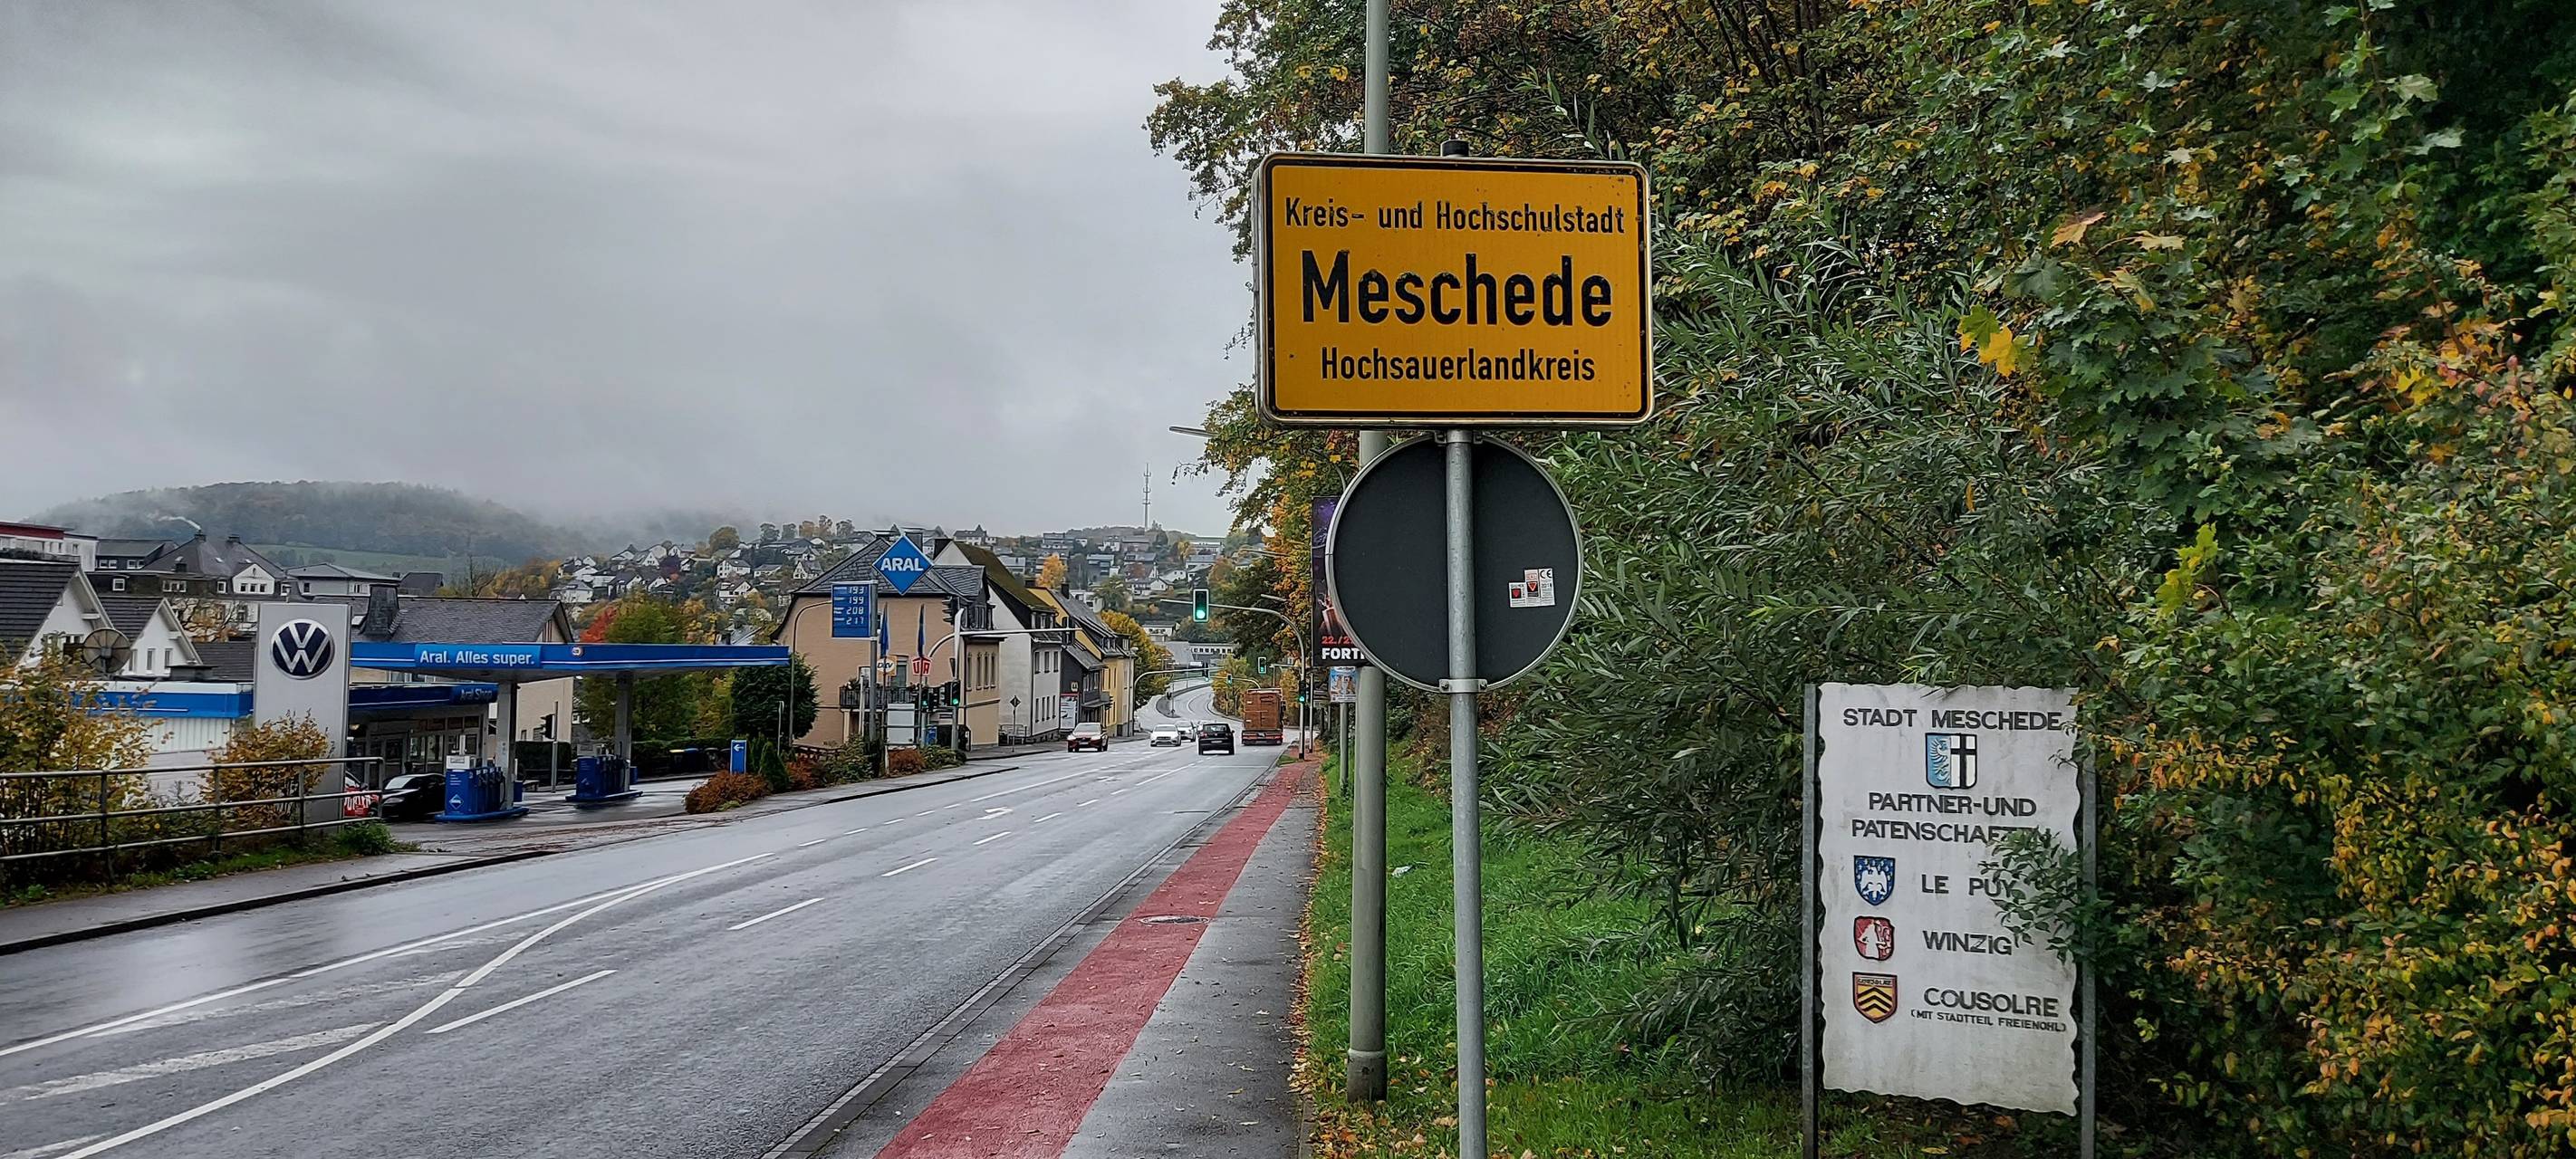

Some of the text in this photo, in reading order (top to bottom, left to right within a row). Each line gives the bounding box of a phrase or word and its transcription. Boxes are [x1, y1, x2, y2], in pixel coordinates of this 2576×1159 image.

[1285, 196, 1625, 234] Kreis- und Hochschulstadt
[1302, 249, 1612, 327] Meschede
[1321, 346, 1596, 381] Hochsauerlandkreis
[880, 558, 924, 571] ARAL
[846, 607, 864, 615] 208
[1322, 636, 1353, 645] 22./2
[419, 650, 535, 666] Aral. Alles super.
[1843, 708, 2062, 731] STADT MESCHEDE
[1869, 792, 2037, 817] PARTNER-UND
[1851, 819, 2051, 848] PATENSCHAF
[1921, 874, 2016, 897] LE PUY
[1924, 987, 2059, 1018] COUSOLRE
[1937, 1011, 1994, 1026] STADTTEIL
